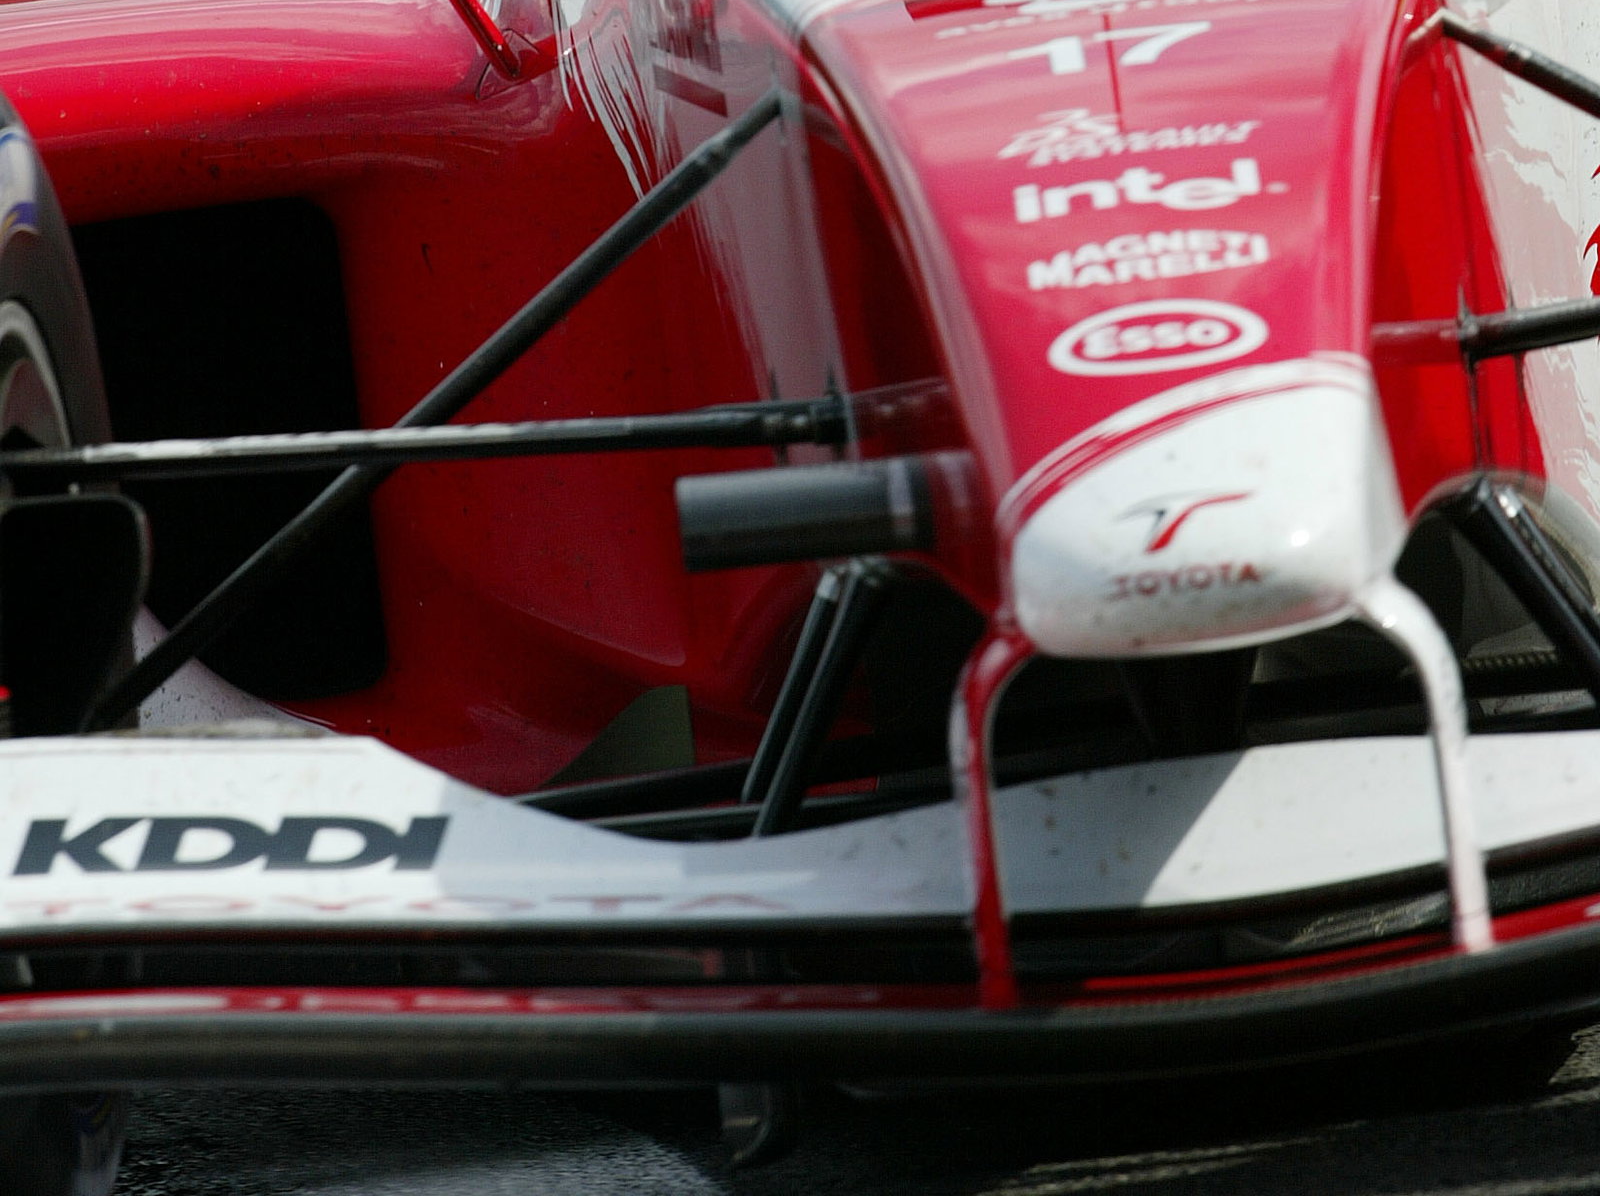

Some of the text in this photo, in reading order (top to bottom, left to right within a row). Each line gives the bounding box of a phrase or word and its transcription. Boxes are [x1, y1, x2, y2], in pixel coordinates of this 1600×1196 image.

[1006, 20, 1213, 76] 17
[1109, 562, 1266, 601] TOYOTA
[13, 815, 452, 876] KDDI
